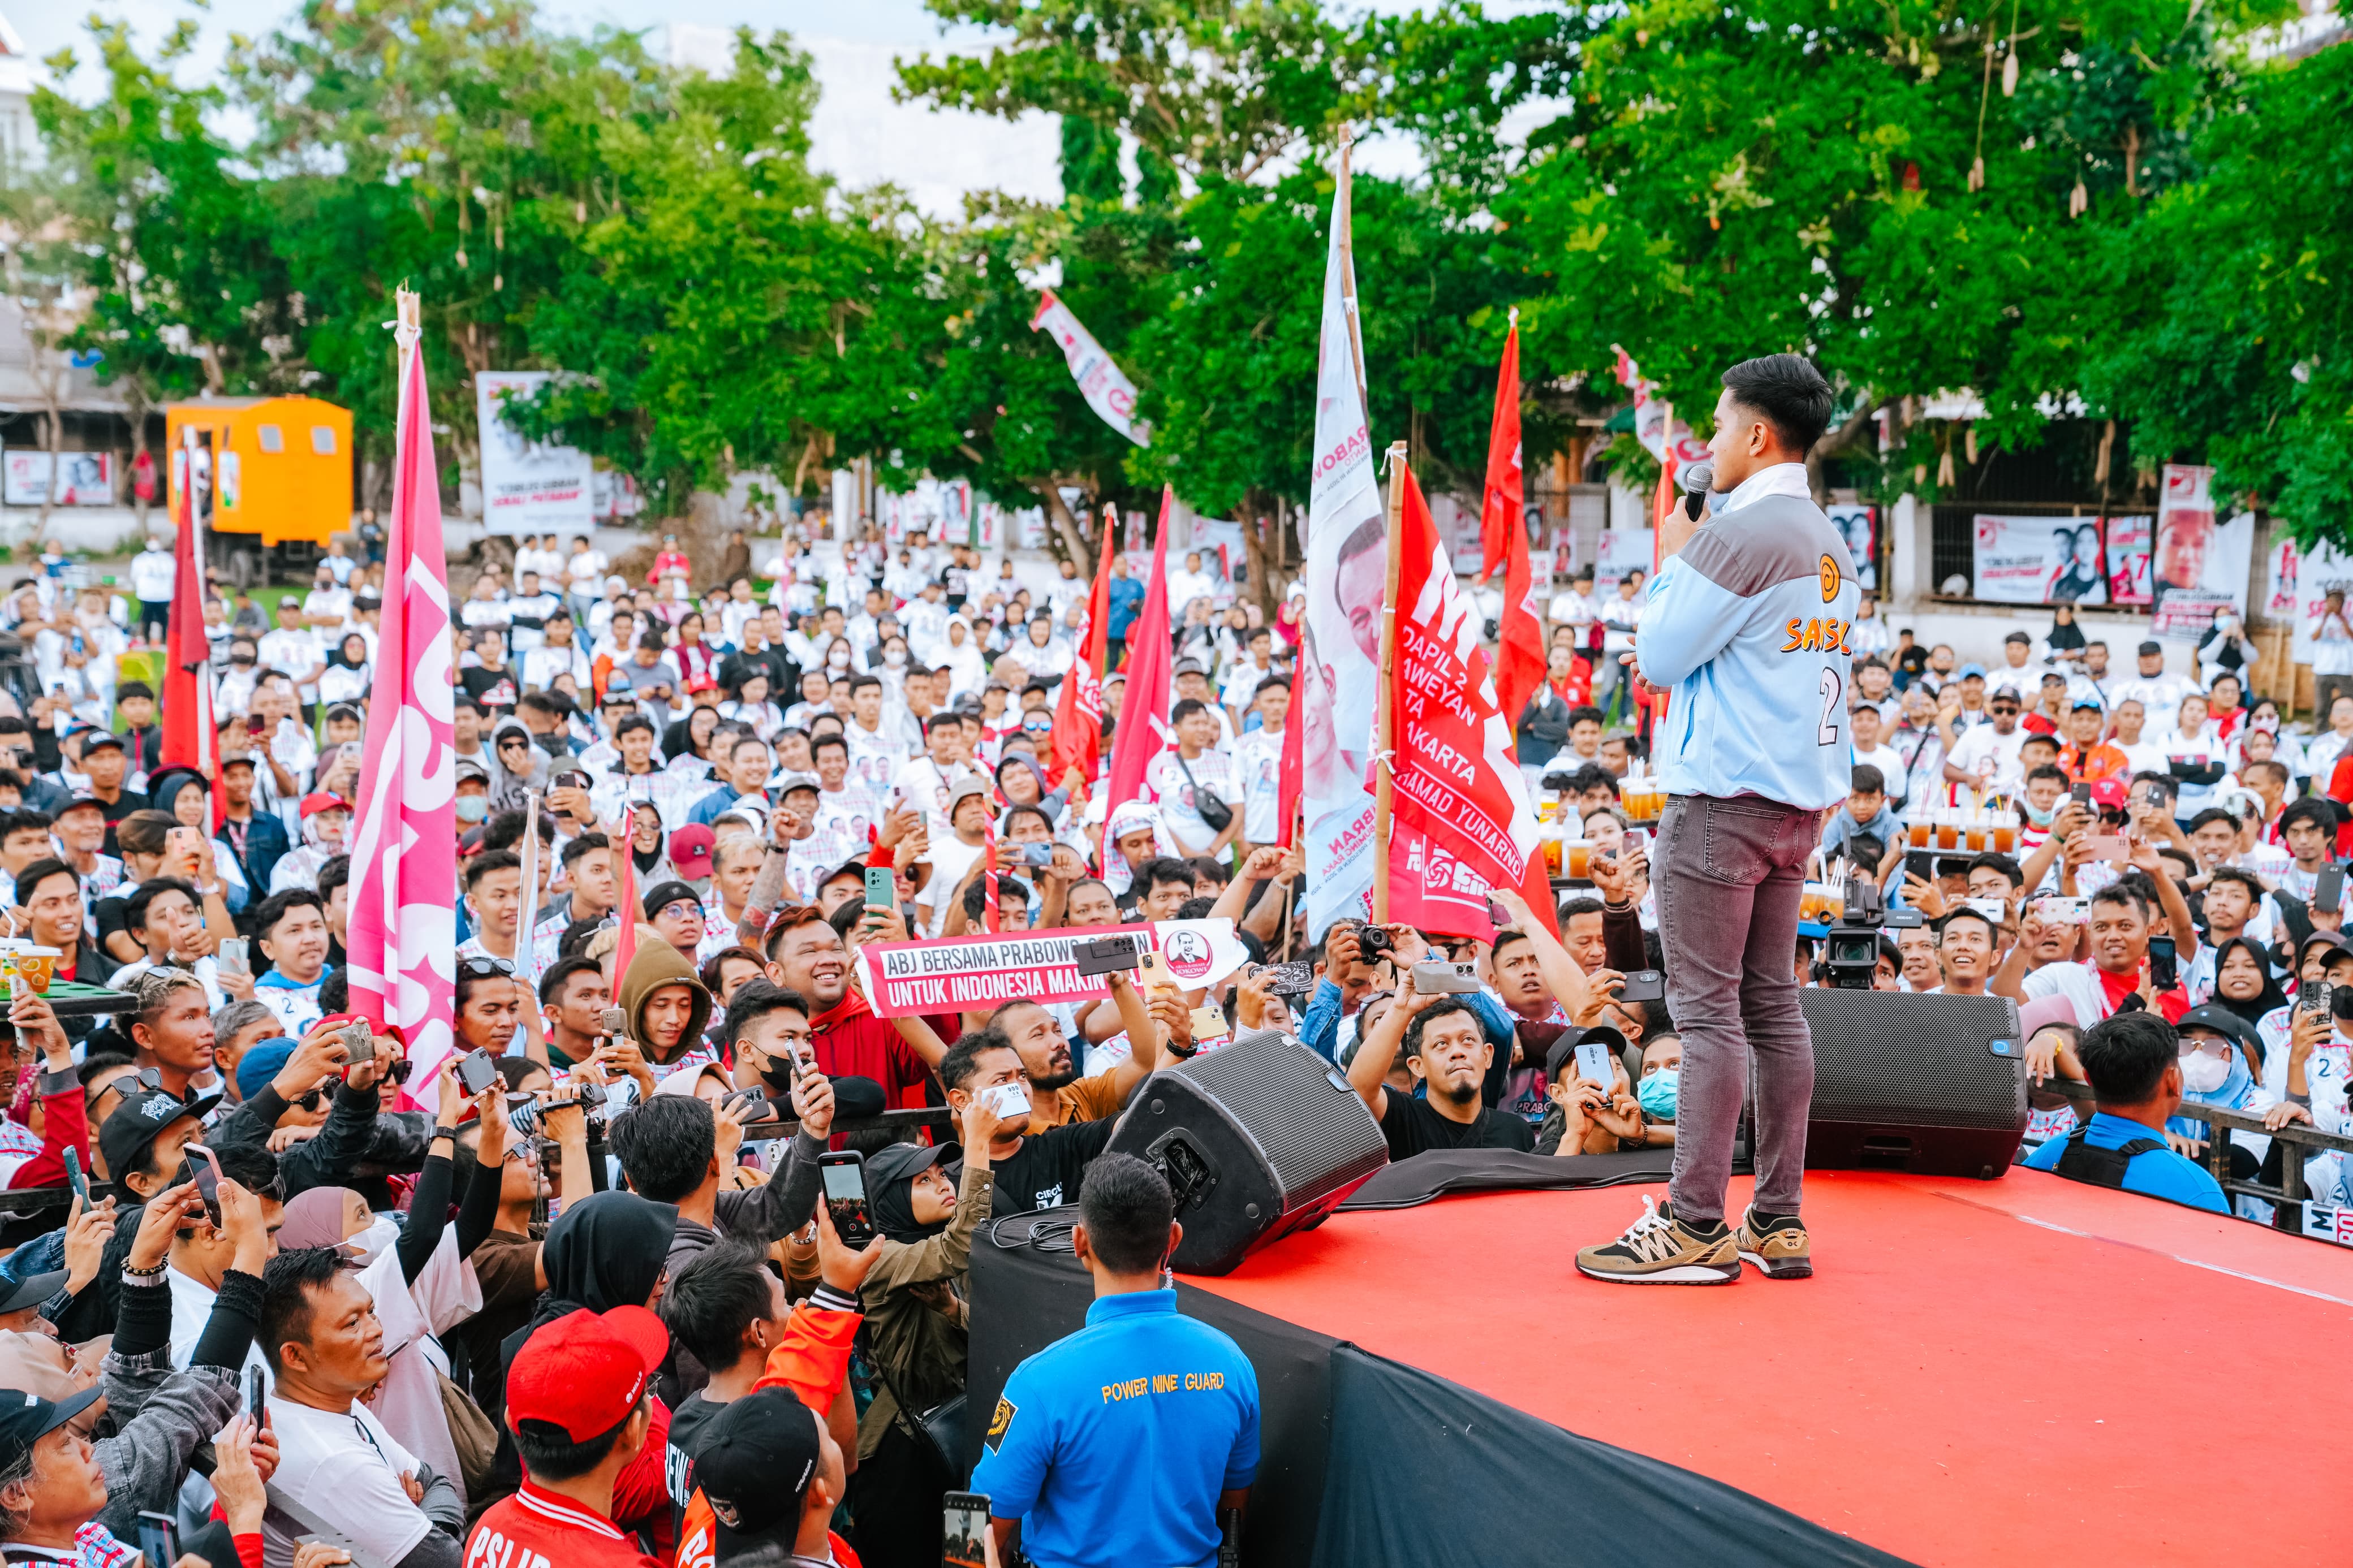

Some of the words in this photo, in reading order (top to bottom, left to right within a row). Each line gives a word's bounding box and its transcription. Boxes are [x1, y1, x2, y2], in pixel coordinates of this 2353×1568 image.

[2136, 554, 2150, 580] 7
[1403, 625, 1451, 679] DAPIL
[1454, 672, 1468, 692] 2
[1406, 688, 1425, 720] TA
[1818, 666, 1841, 746] 2
[2099, 781, 2115, 794] T
[888, 951, 917, 976] ABJ
[921, 944, 999, 973] BERSAMA
[1176, 966, 1208, 975] JOKOWI
[887, 977, 946, 1008] UNTUK
[952, 971, 1044, 1003] INDONESIA
[1048, 967, 1107, 994] MAKIN
[282, 997, 295, 1014] 2
[2318, 1058, 2331, 1077] 2
[631, 1370, 643, 1396] MILLS
[1101, 1377, 1148, 1405] POWER
[1152, 1373, 1179, 1394] NINE
[1184, 1372, 1225, 1391] GUARD
